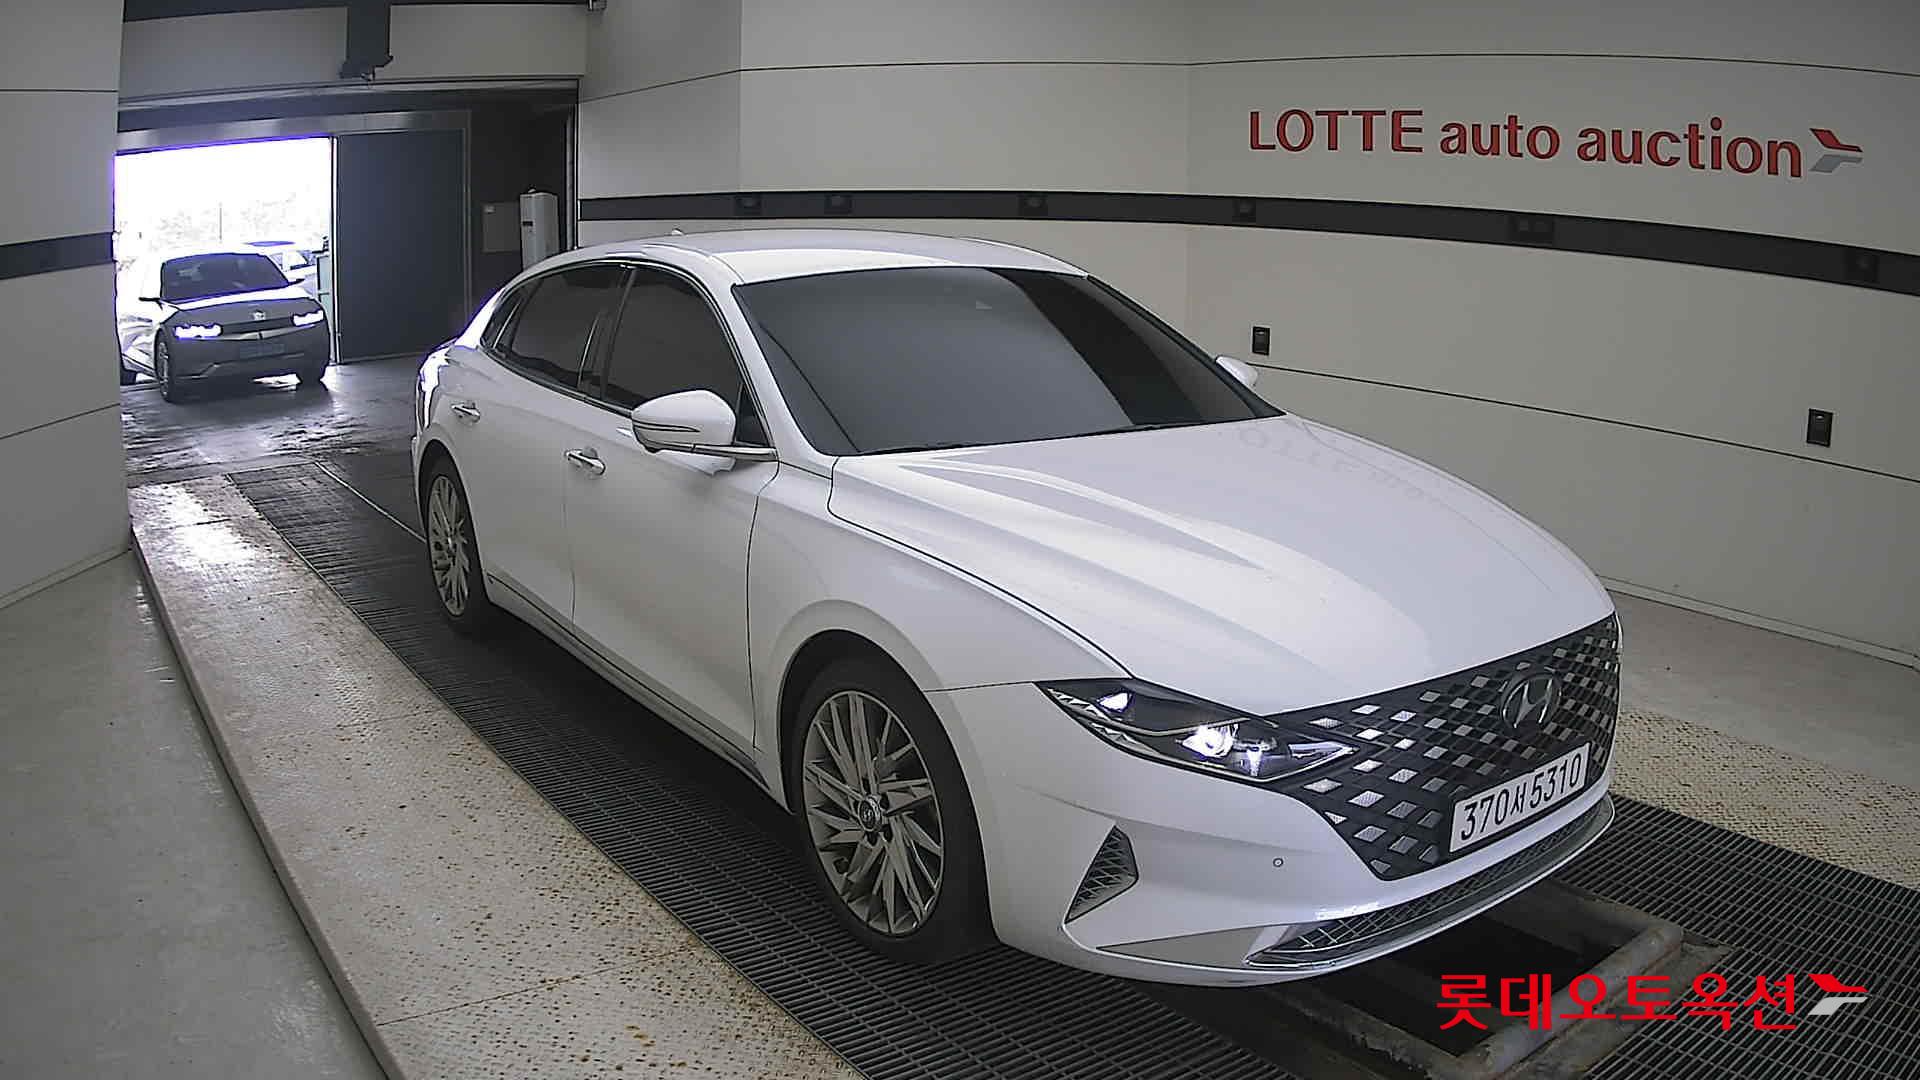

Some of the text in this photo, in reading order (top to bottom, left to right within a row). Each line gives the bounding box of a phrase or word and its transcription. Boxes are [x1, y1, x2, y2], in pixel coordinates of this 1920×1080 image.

[1249, 110, 1803, 178] LOTTE auto auction
